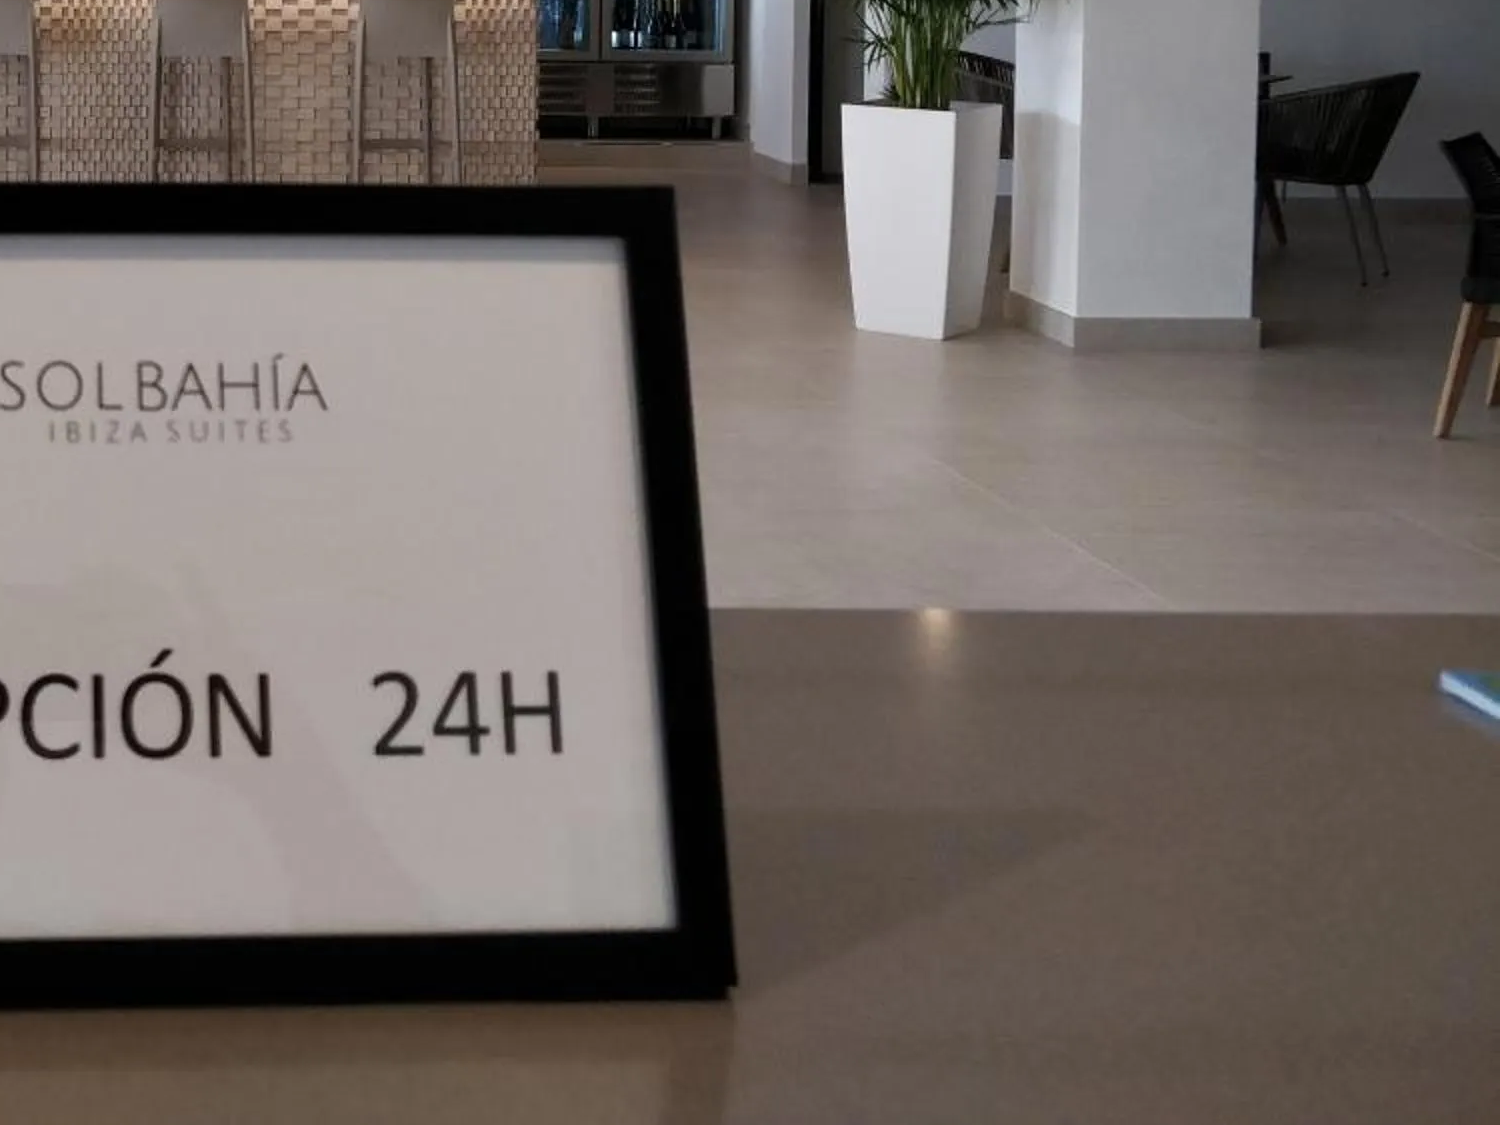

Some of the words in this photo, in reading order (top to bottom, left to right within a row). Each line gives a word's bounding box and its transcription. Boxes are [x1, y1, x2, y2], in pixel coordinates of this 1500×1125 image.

[48, 420, 148, 445] IBIZA
[166, 419, 293, 445] SUITES
[371, 671, 564, 756] 24H
